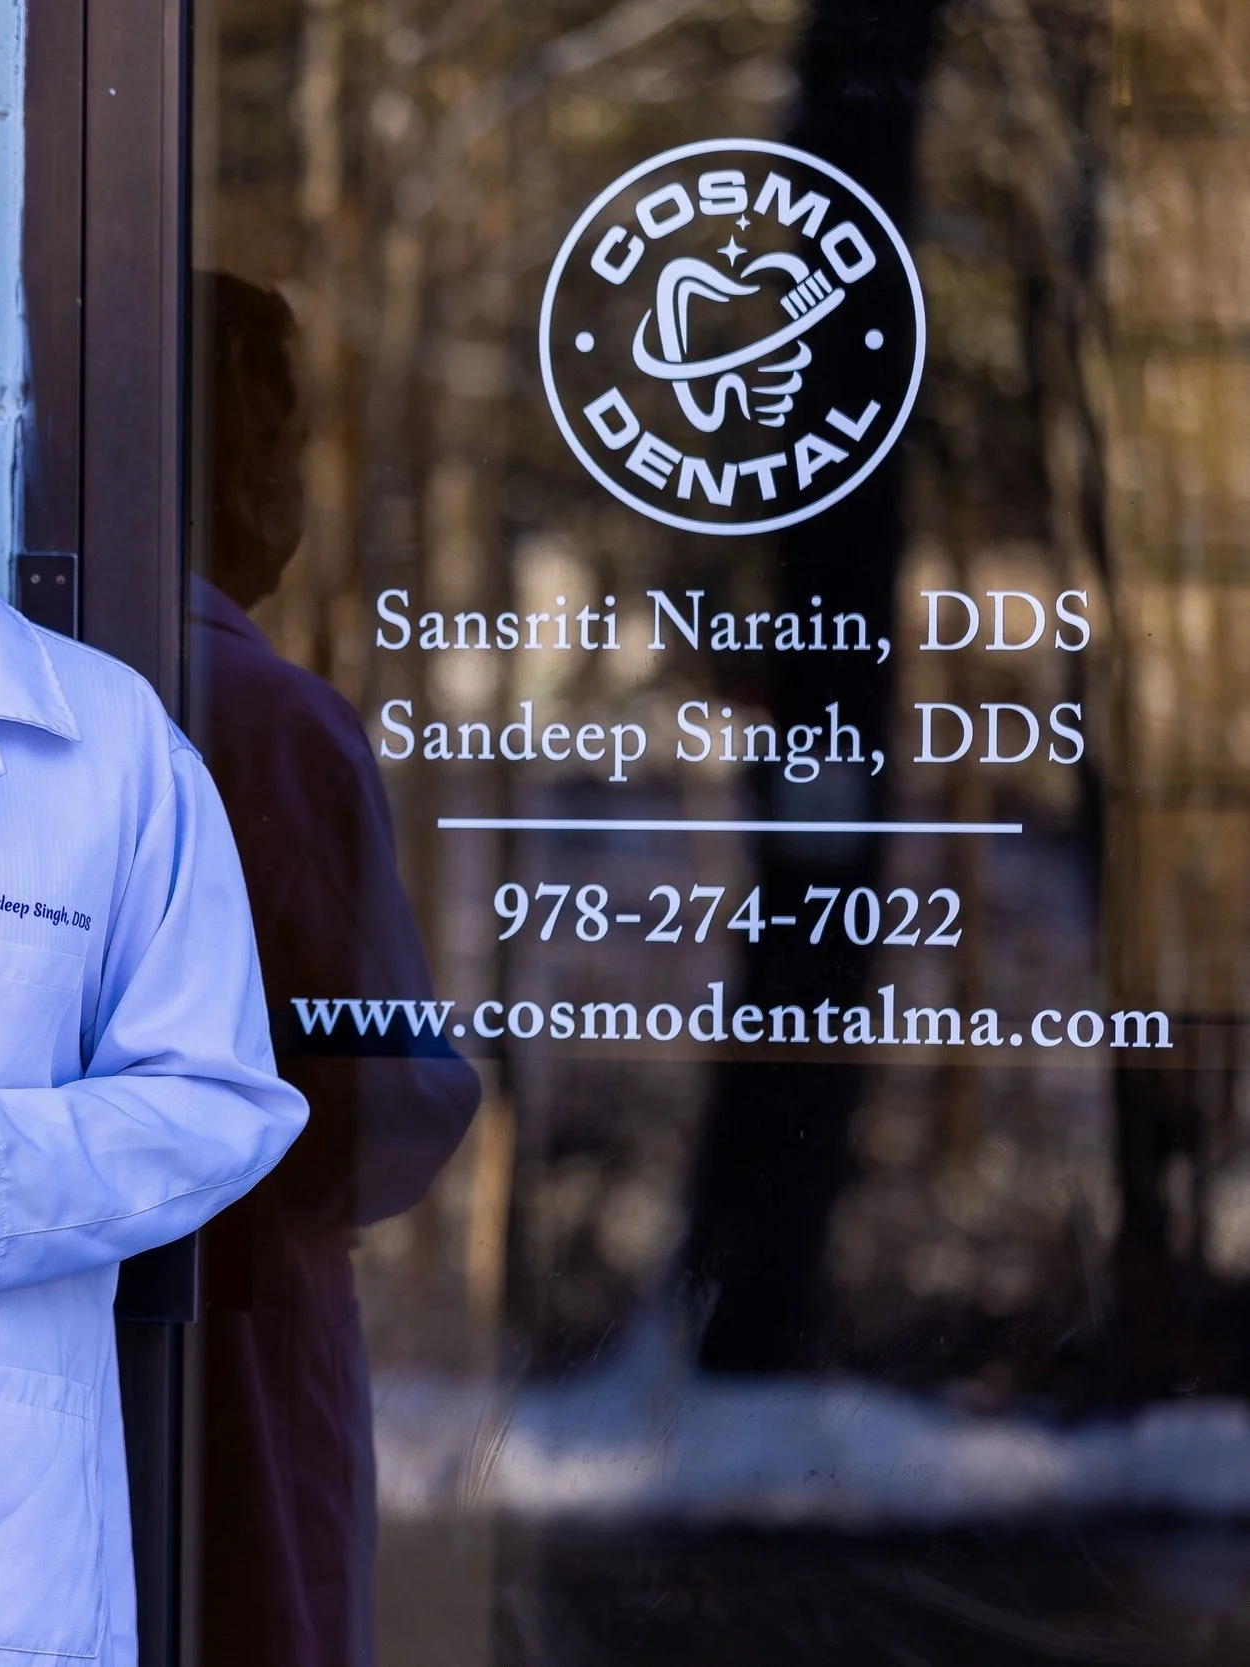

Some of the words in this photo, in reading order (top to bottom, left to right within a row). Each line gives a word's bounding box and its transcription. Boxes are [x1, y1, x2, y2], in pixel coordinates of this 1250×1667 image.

[590, 169, 877, 285] COSMO
[582, 386, 882, 507] DENTAL
[375, 589, 620, 651] Sansriti
[645, 590, 891, 664] Narain,
[919, 590, 1091, 653] DDS
[379, 699, 648, 782] Sandeep
[675, 700, 885, 784] Singh,
[912, 702, 1086, 765] DDS
[33, 902, 70, 926] Singh,
[71, 910, 92, 931] DDS
[493, 881, 963, 948] 978-274-7022
[290, 981, 1175, 1049] www.cosmodentalma.com
